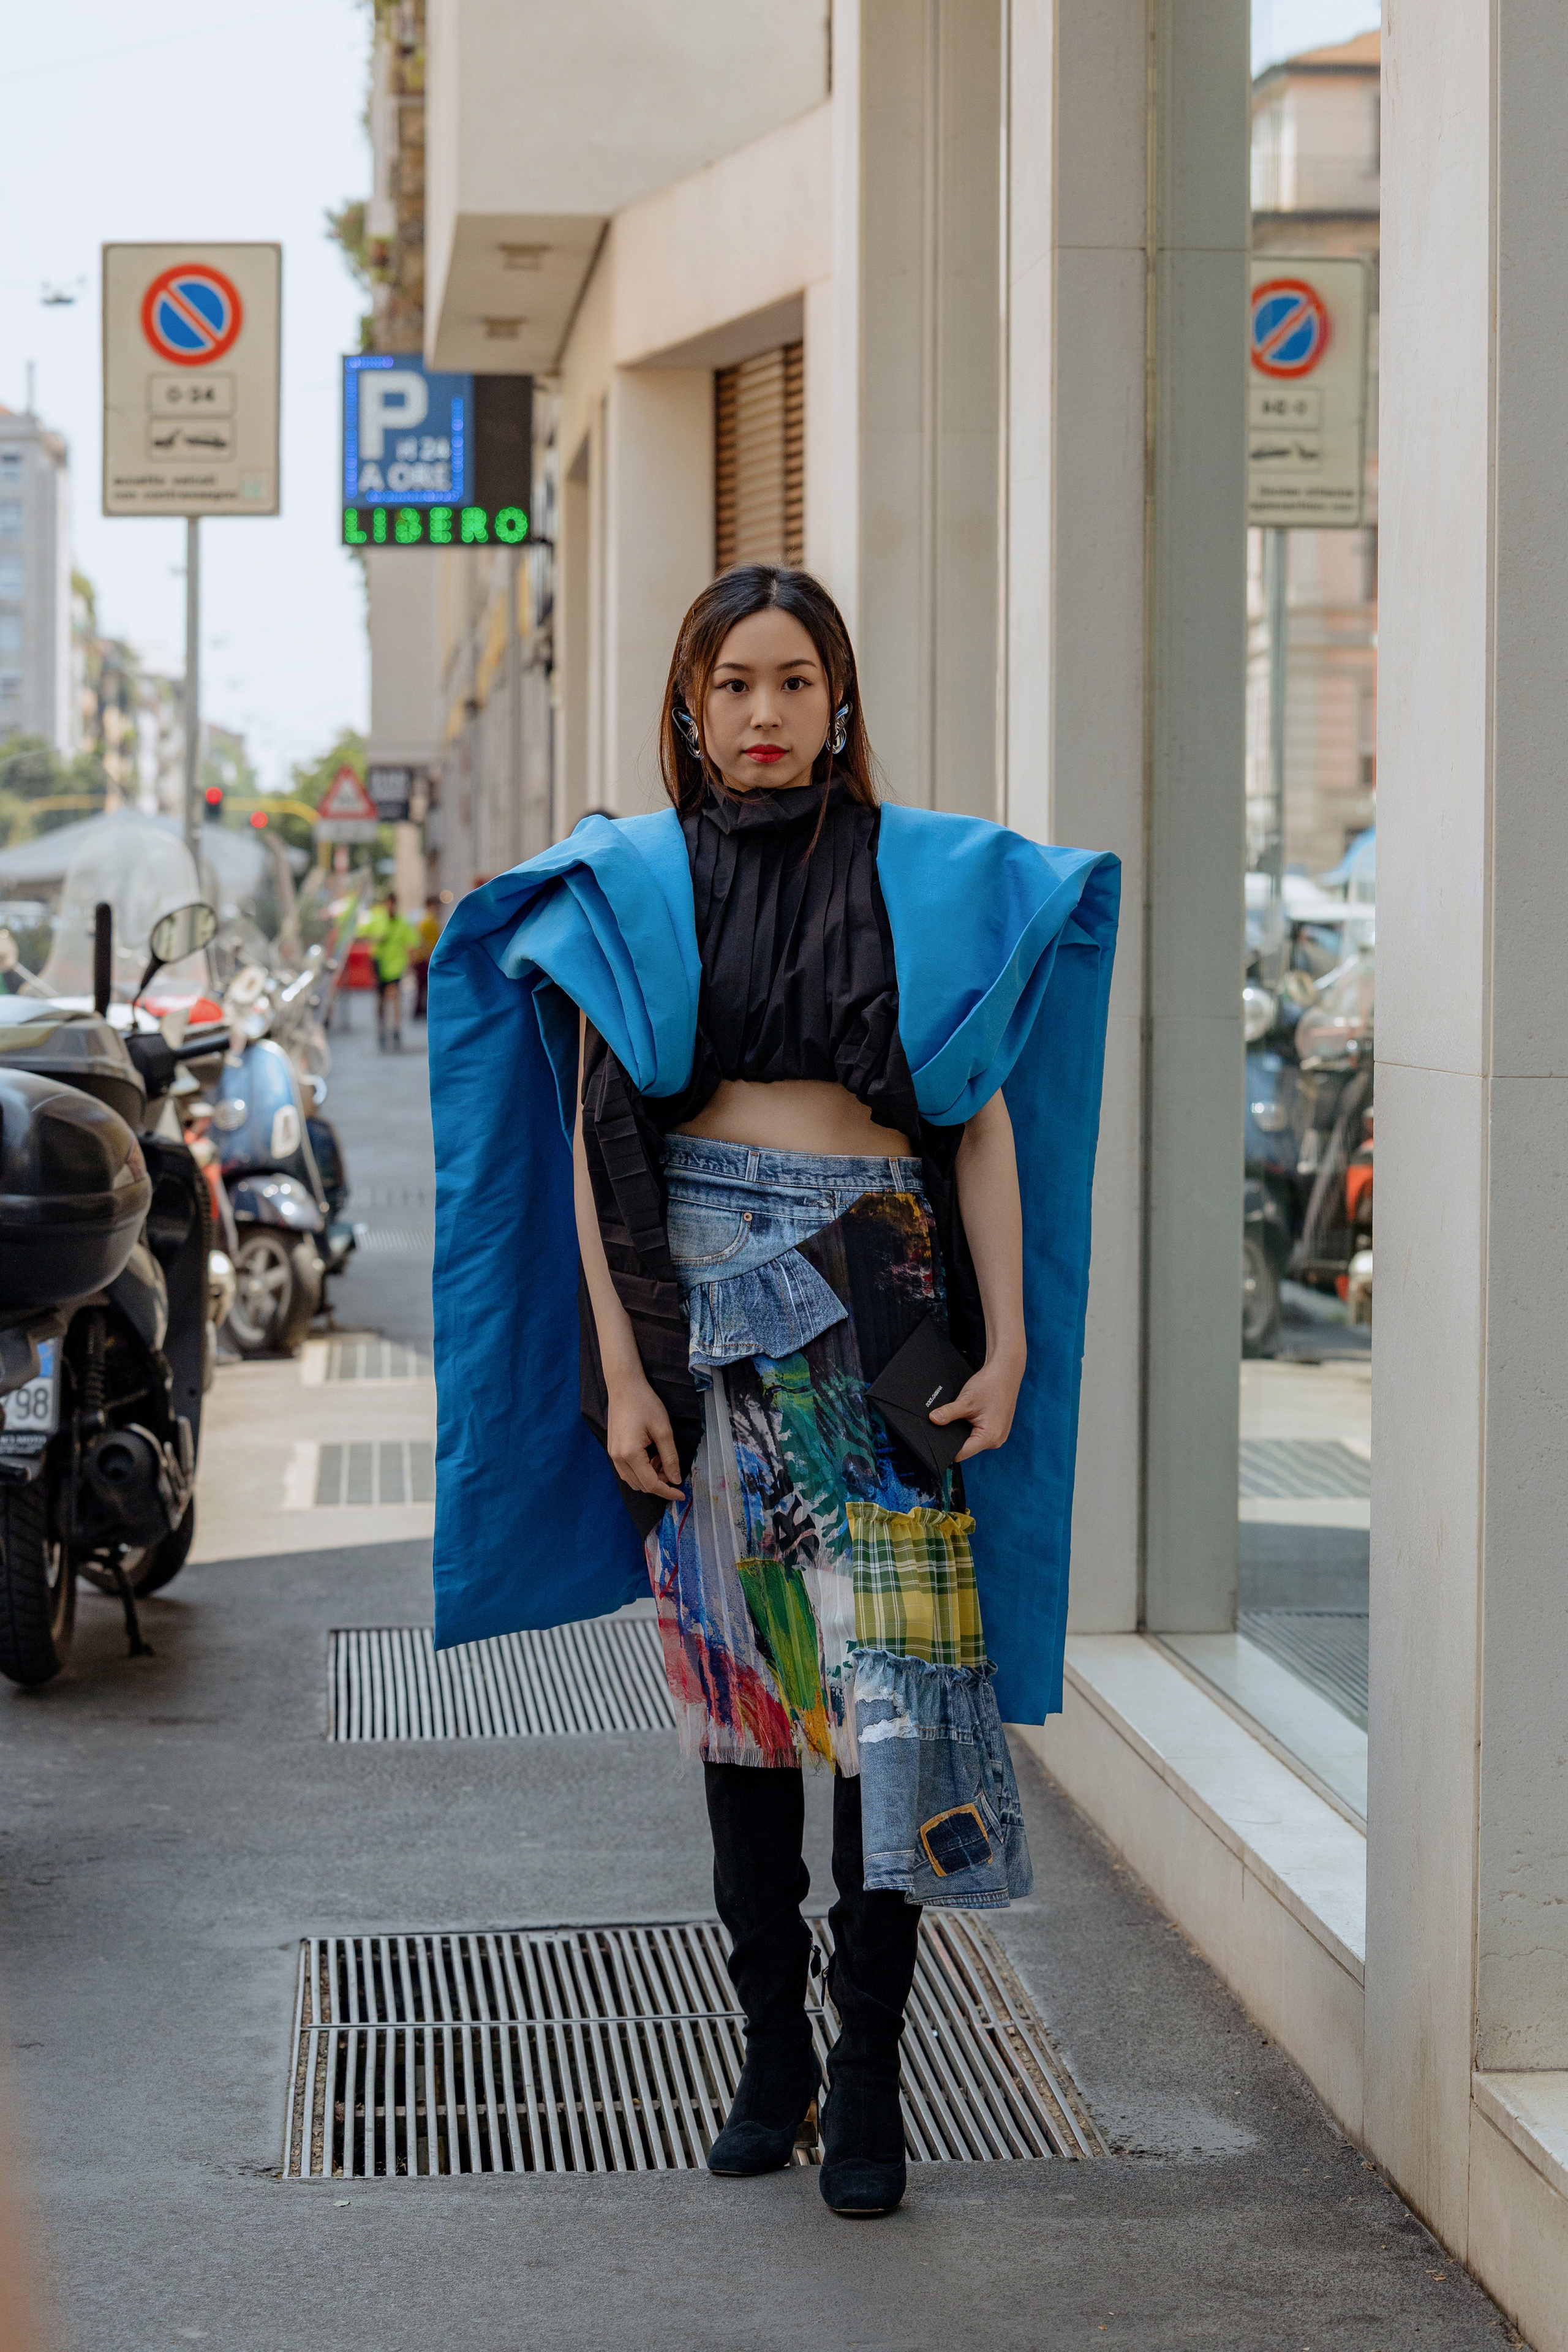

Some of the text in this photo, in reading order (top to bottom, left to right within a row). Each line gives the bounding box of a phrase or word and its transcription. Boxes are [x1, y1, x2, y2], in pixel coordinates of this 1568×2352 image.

[359, 370, 428, 459] P
[358, 462, 385, 492] A
[345, 507, 528, 543] LIBERO
